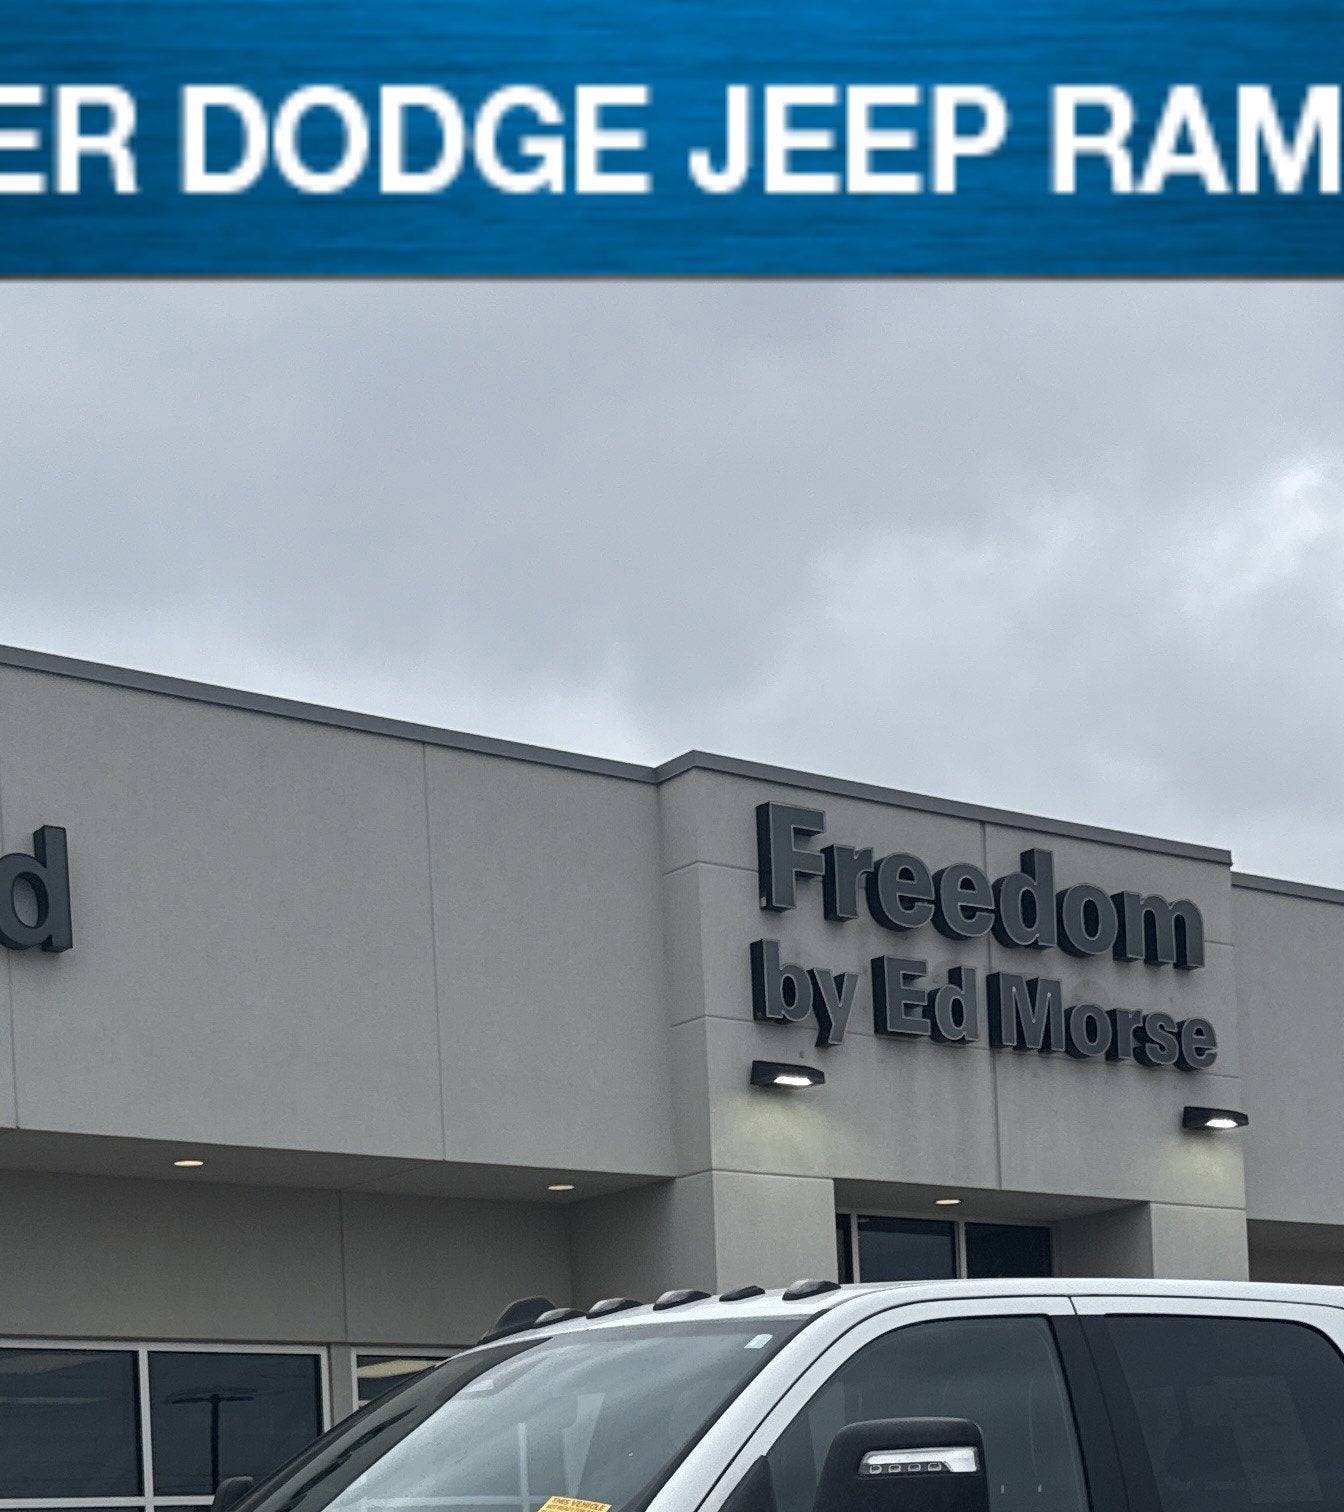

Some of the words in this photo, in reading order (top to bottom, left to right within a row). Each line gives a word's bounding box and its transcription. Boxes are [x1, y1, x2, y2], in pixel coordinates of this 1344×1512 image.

[756, 801, 1205, 969] Freedom
[750, 938, 859, 1046] by
[871, 955, 980, 1043] Ed
[987, 971, 1218, 1071] Morse
[571, 1501, 606, 1511] VEHICLE
